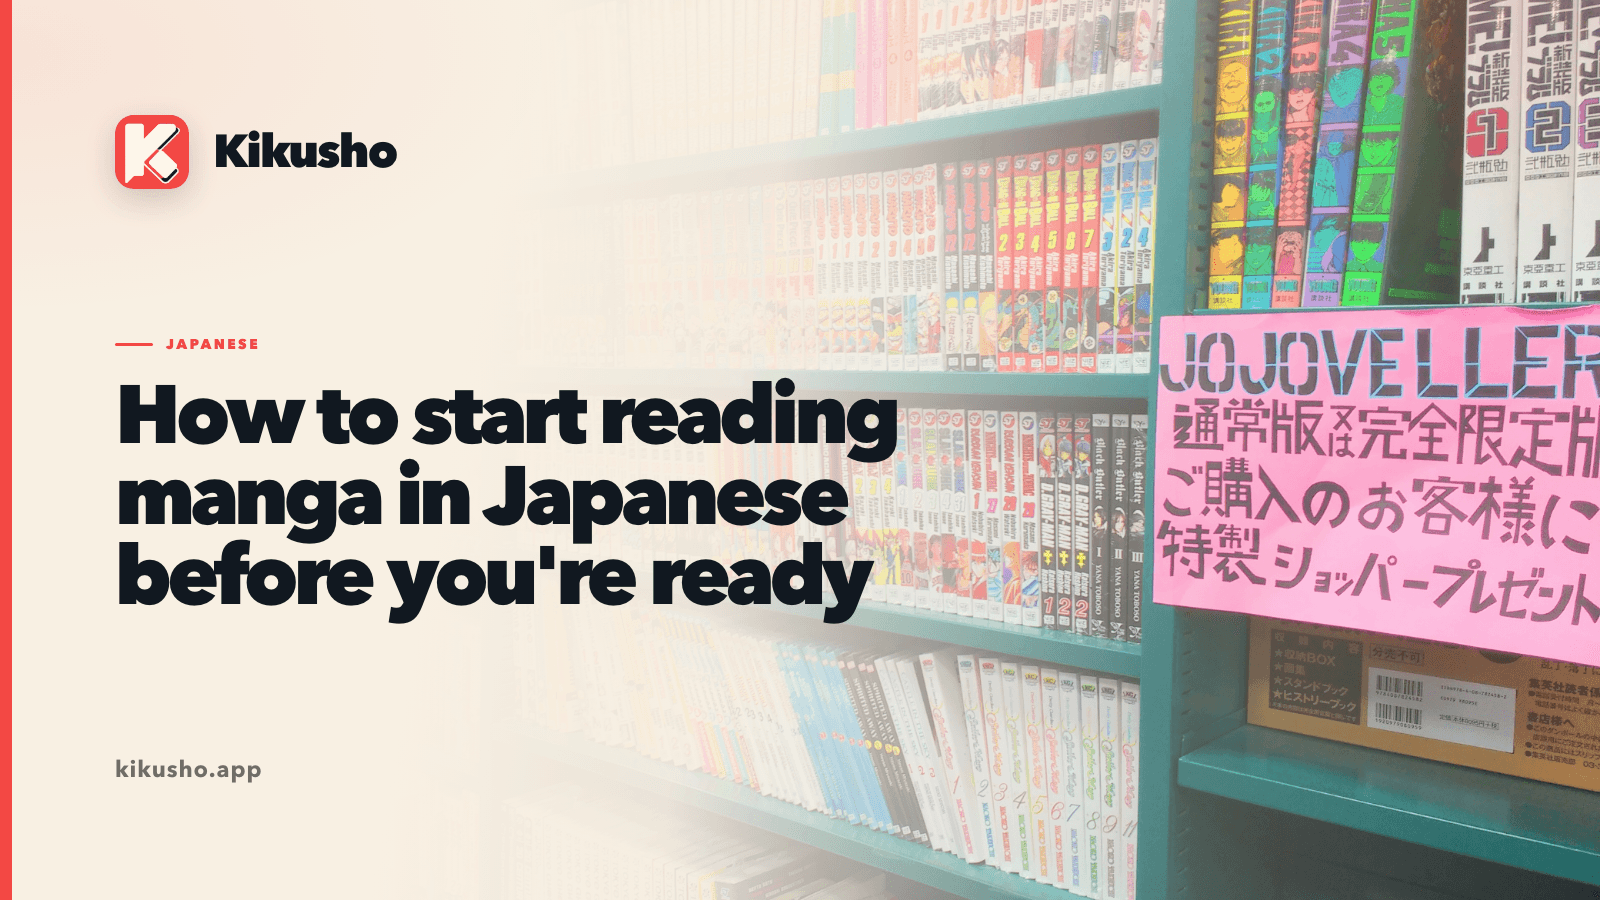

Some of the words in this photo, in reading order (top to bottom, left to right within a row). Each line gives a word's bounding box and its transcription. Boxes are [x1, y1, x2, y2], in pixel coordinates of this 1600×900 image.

[998, 234, 1008, 252] 2
[1016, 232, 1025, 251] 3
[1031, 235, 1040, 253] 4
[1048, 230, 1057, 249] 5
[1066, 231, 1076, 251] 6
[1084, 229, 1095, 248] 7
[1102, 232, 1113, 251] 3
[1121, 228, 1132, 248] 2
[1138, 227, 1149, 247] 4
[1162, 456, 1600, 555] ご購入のお客様に
[1044, 597, 1054, 614] 1
[1058, 598, 1072, 616] 2
[1075, 600, 1090, 618] 2
[978, 780, 990, 799] 2
[1014, 792, 1028, 809] 4
[1033, 795, 1049, 815] 5
[1051, 802, 1065, 821] 6
[1067, 804, 1081, 822] 7
[1087, 811, 1100, 831] 8
[1103, 815, 1118, 834] 9
